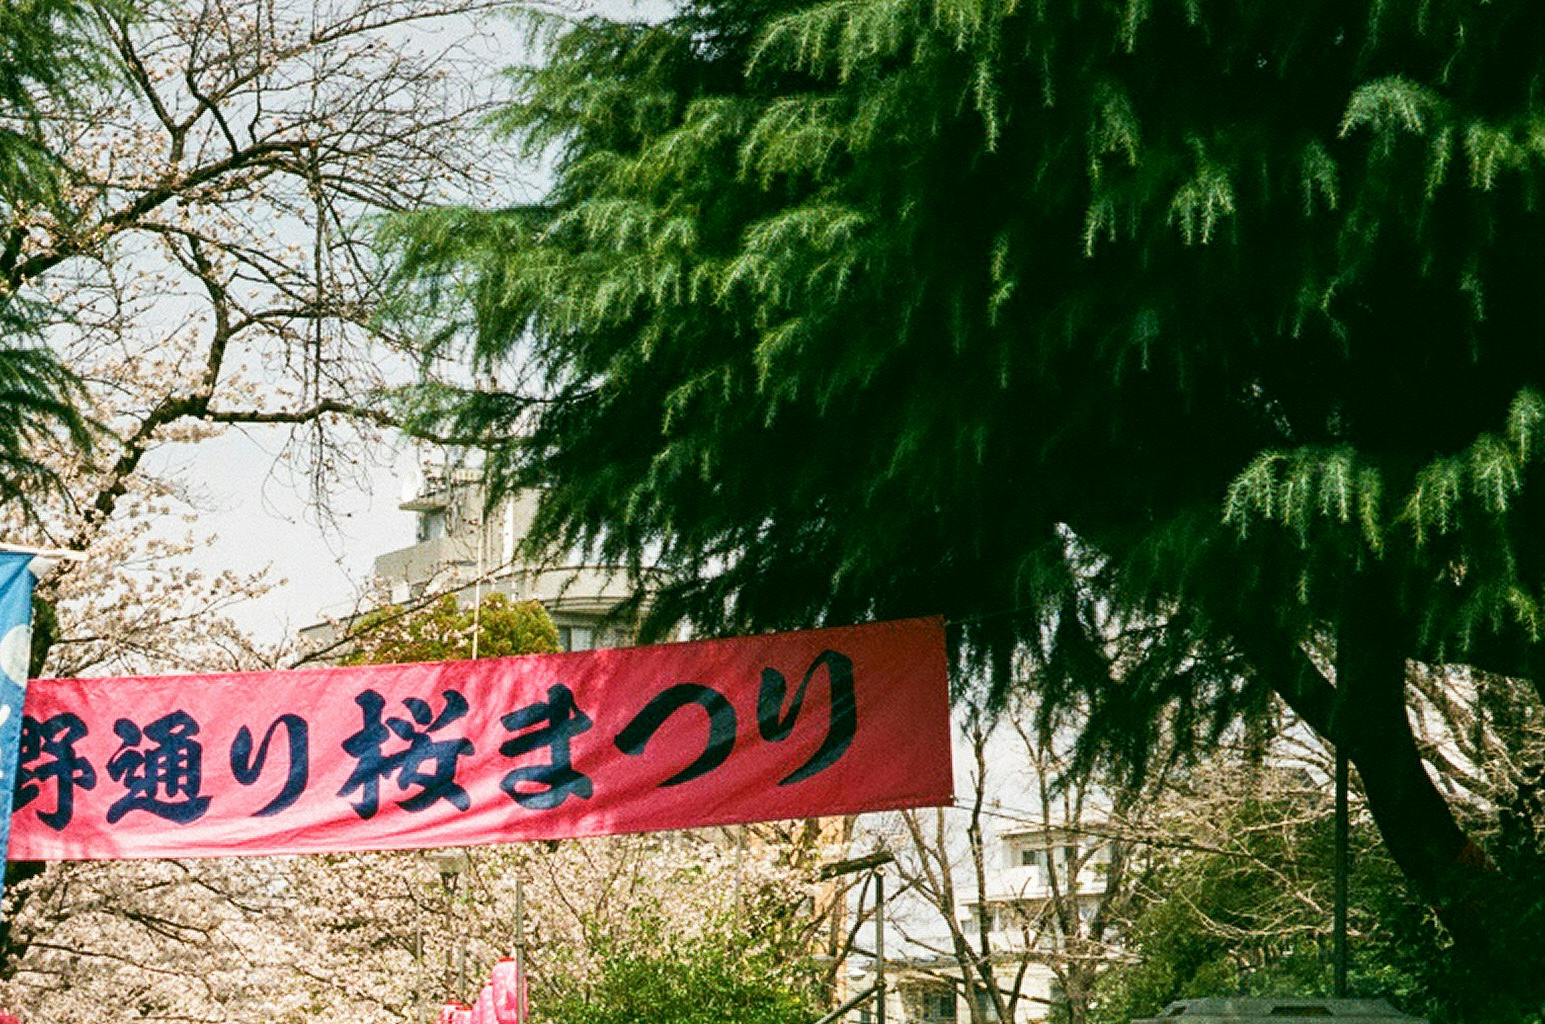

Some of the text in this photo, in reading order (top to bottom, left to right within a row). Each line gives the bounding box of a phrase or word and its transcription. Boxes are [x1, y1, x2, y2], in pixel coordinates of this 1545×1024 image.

[12, 648, 858, 831] 野通り桜まつり
